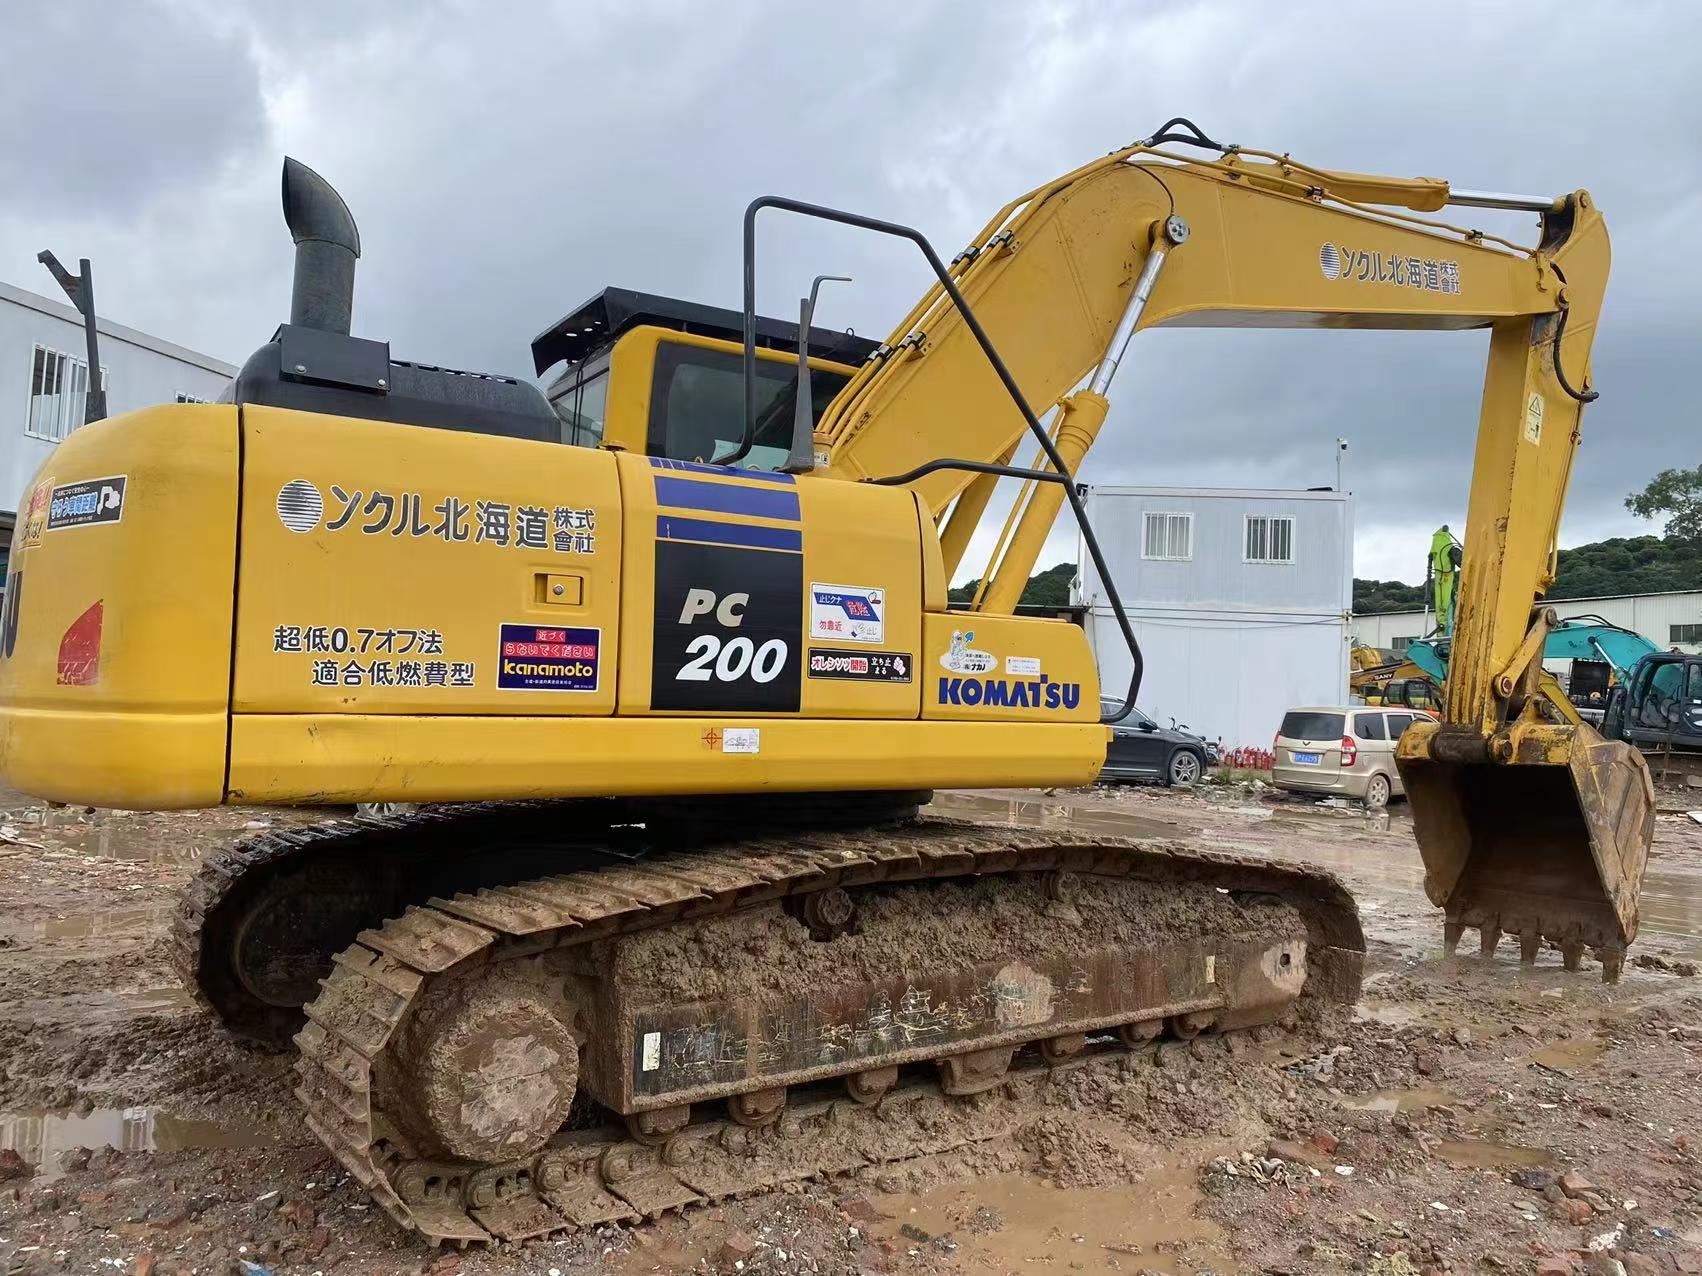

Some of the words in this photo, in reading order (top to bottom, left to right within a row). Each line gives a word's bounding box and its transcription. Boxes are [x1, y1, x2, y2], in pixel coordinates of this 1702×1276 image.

[678, 588, 749, 627] PC
[311, 659, 475, 687] 適合低燃費型
[504, 659, 593, 676] kanamoto
[675, 634, 788, 683] 200
[938, 674, 1080, 709] KOMATSU
